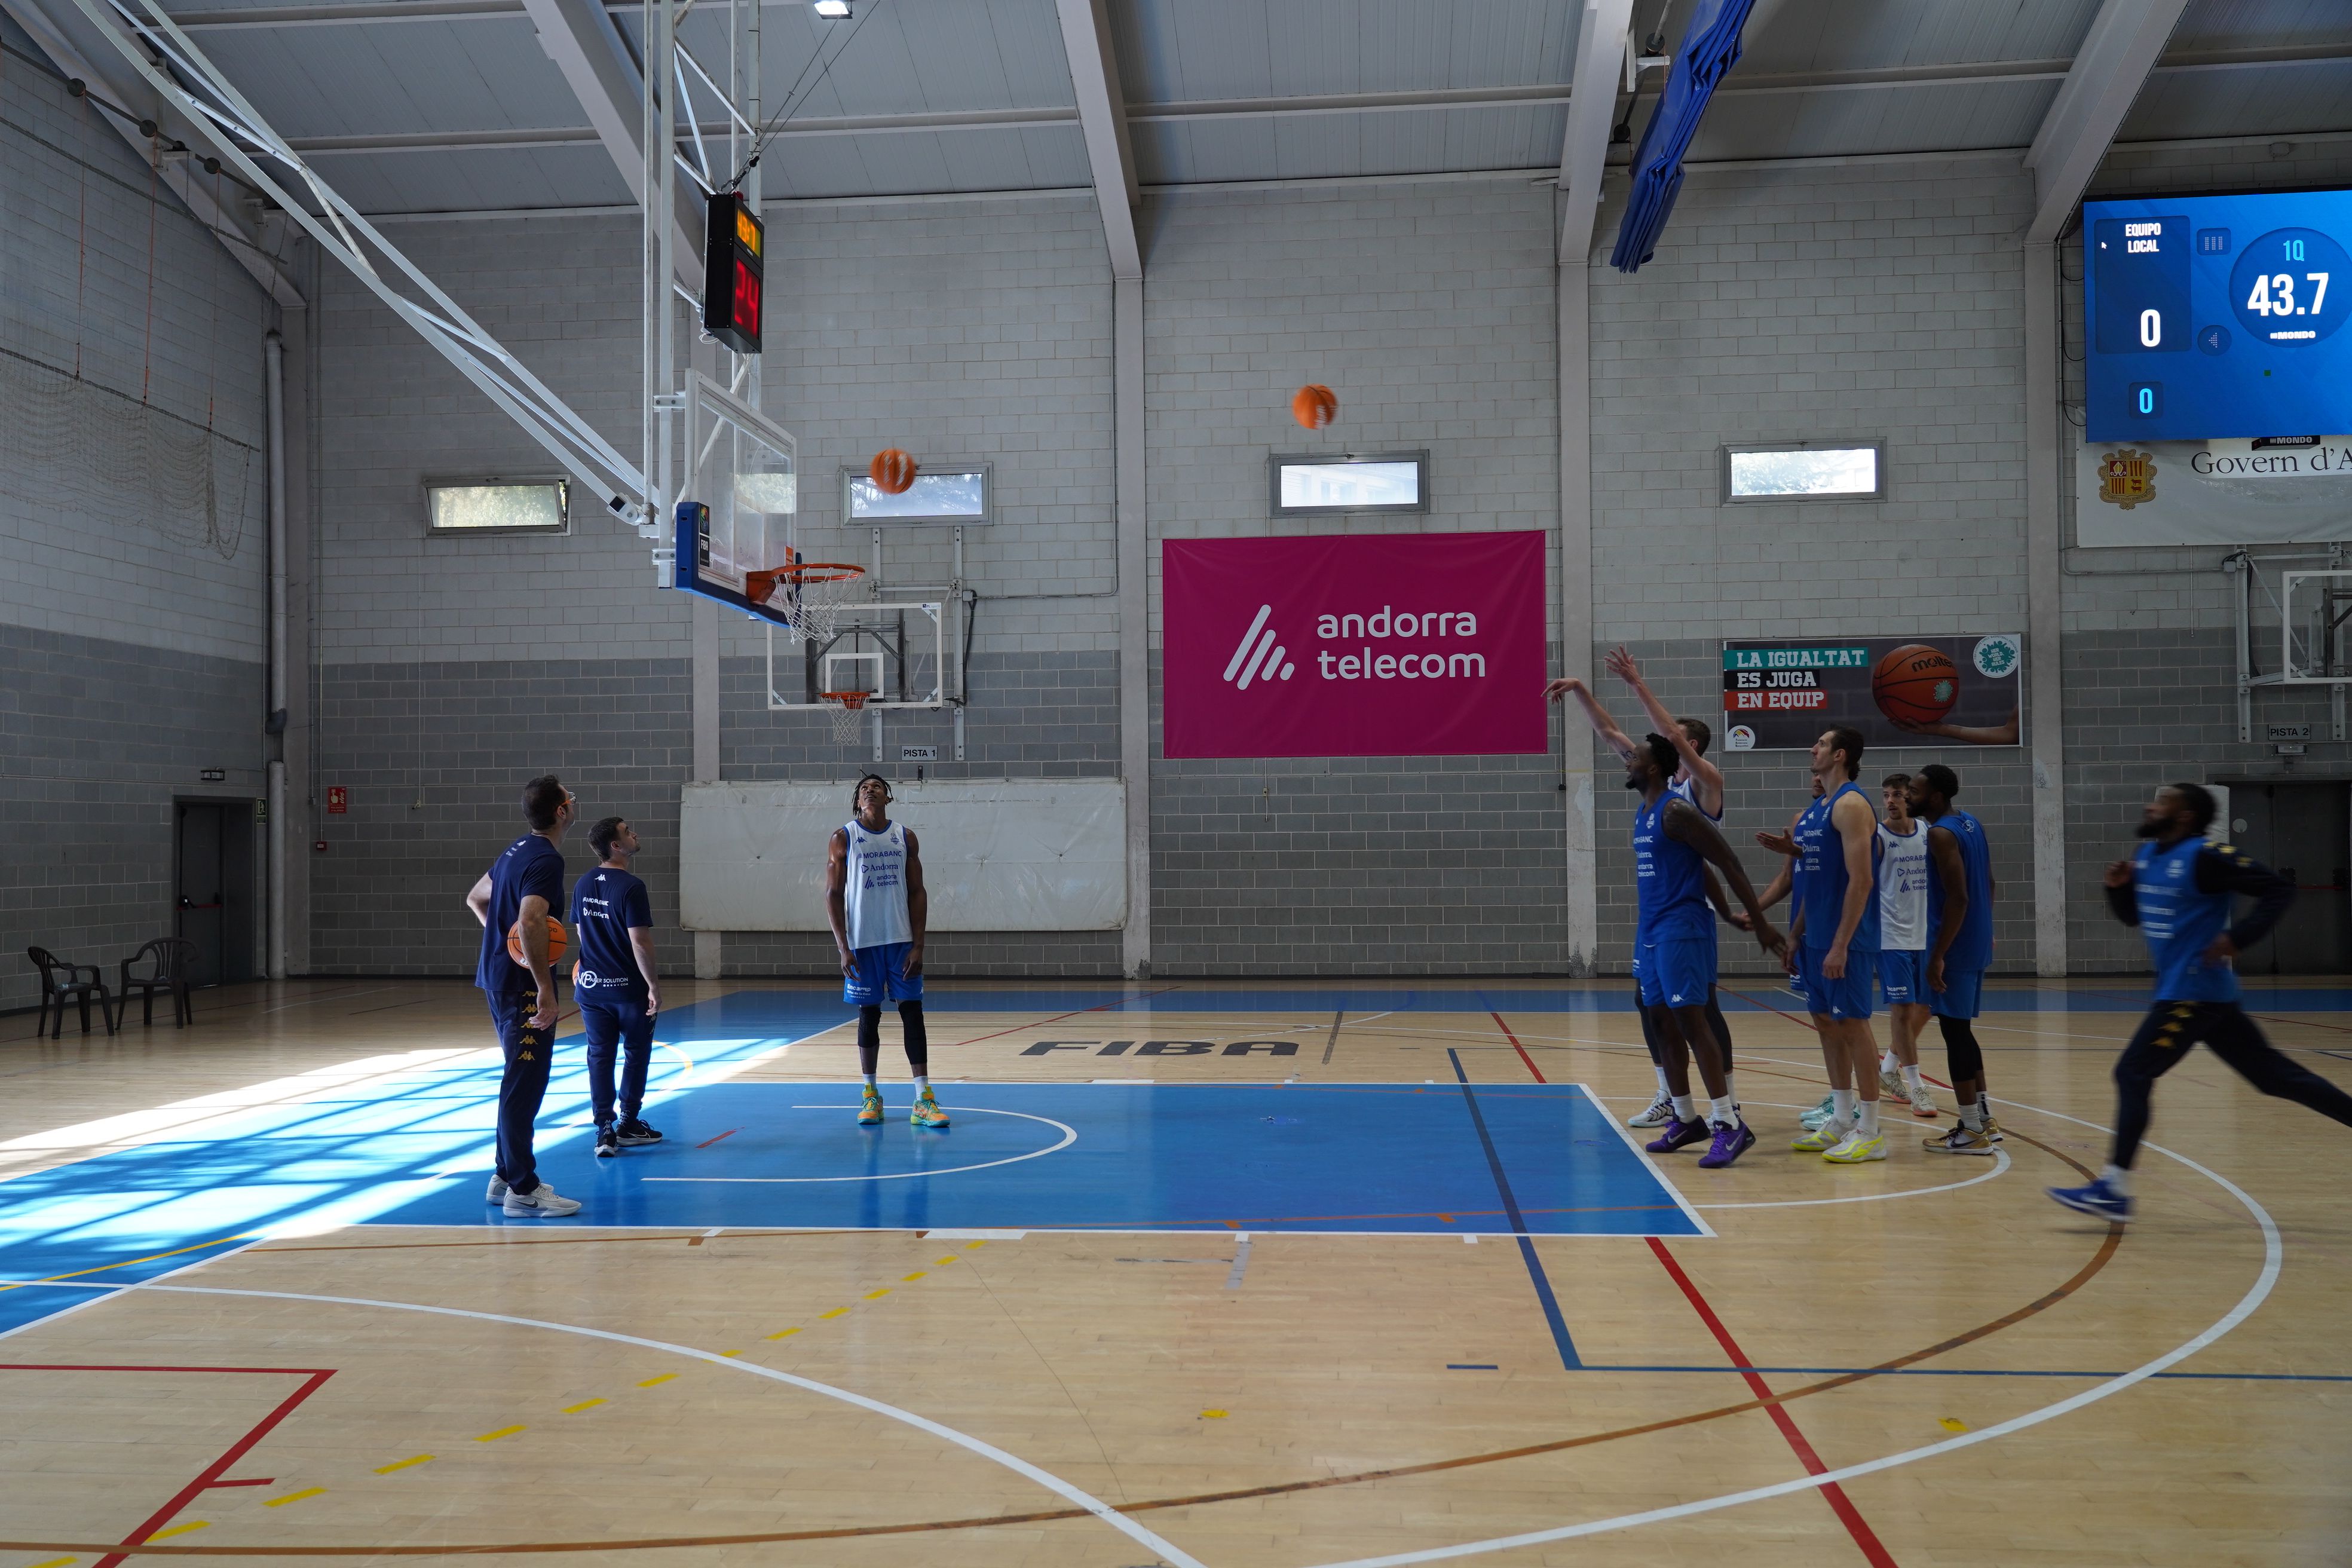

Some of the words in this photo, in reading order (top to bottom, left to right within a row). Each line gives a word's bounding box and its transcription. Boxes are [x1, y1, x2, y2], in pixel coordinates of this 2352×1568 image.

[2126, 223, 2161, 237] EQUIPO
[2127, 240, 2159, 253] LOCAL
[2283, 240, 2304, 261] 1Q
[2247, 272, 2329, 316] 43.7
[2140, 309, 2161, 347] 0
[2277, 330, 2316, 339] MONDO
[2139, 388, 2152, 414] 0
[2277, 436, 2313, 445] MONDO
[2191, 452, 2299, 474] Govern
[1317, 605, 1477, 639] andorra
[1317, 647, 1486, 680] telecom
[1737, 652, 1762, 667] LA
[1768, 650, 1864, 667] IGUALTAT
[1737, 672, 1760, 688] ES
[1766, 671, 1817, 688] JUGA
[1738, 693, 1762, 708] EN
[1768, 691, 1824, 709] EQUIP
[863, 850, 902, 859] MORABANC
[1019, 1042, 1299, 1055] FIBA
